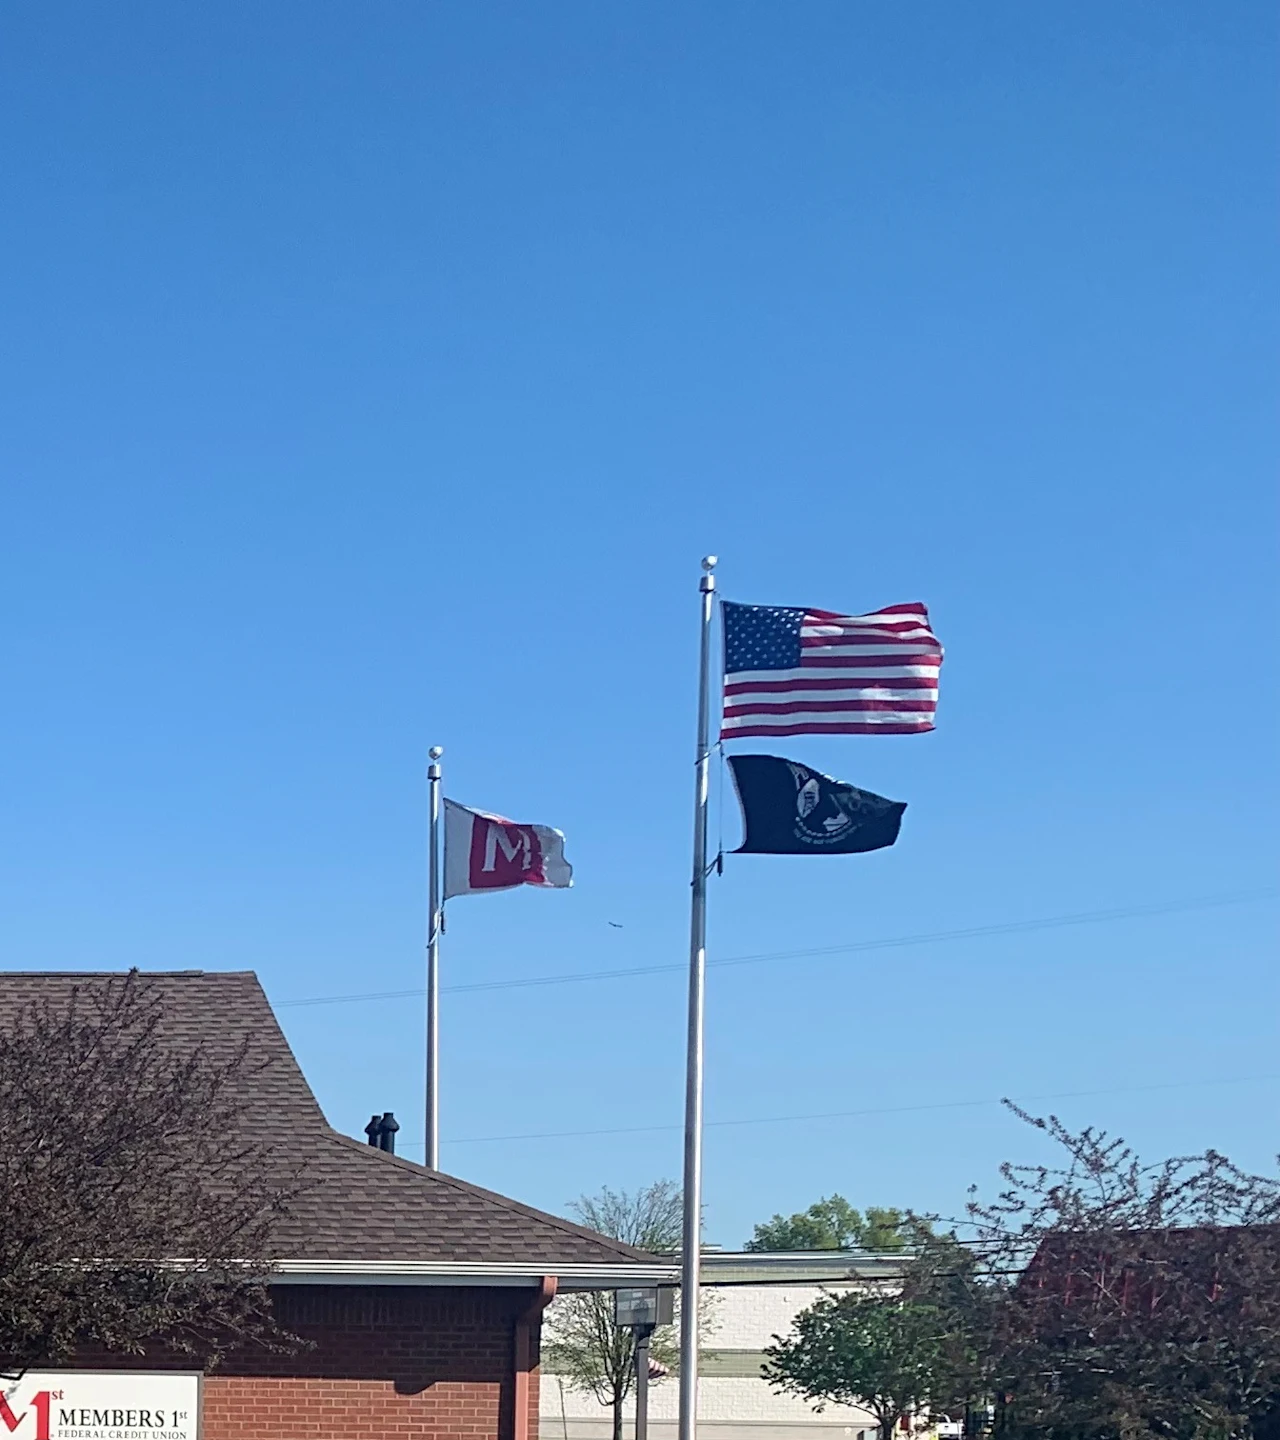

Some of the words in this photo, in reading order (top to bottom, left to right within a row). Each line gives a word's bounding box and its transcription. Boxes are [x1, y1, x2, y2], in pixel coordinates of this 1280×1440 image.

[58, 1408, 166, 1428] MEMBERS
[171, 1410, 188, 1428] 1st
[58, 1429, 106, 1439] FEDERAL
[108, 1430, 149, 1439] CREDIT
[152, 1431, 188, 1440] UNION
